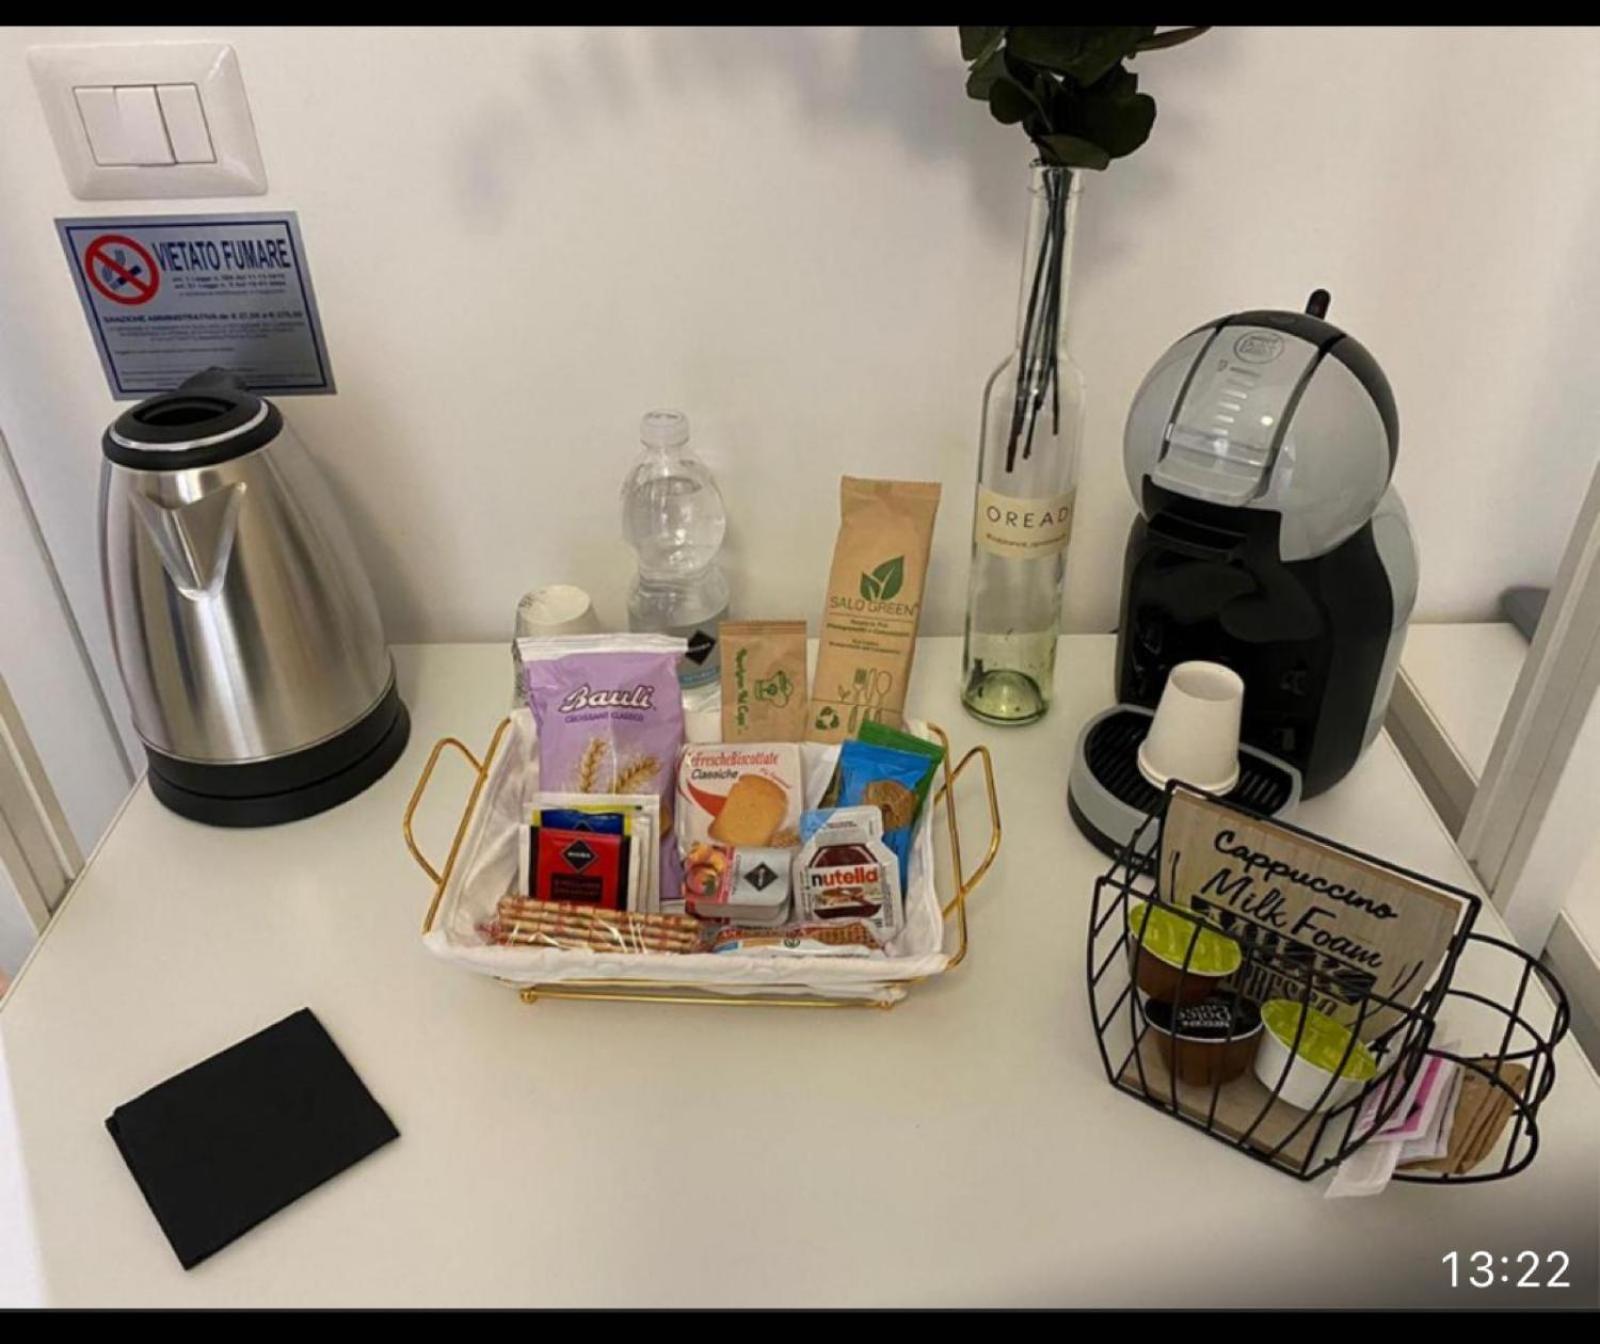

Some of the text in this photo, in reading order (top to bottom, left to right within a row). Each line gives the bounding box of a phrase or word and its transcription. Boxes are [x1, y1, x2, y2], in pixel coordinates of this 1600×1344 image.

[152, 239, 291, 271] VIETATO FUMARE
[986, 505, 1069, 528] OREAD
[867, 601, 915, 617] GREEN
[558, 682, 655, 713] Bauli
[691, 768, 739, 780] Classiche
[811, 867, 879, 888] nutella
[1213, 829, 1398, 919] Cappuccino
[1200, 868, 1383, 969] Milk Foam
